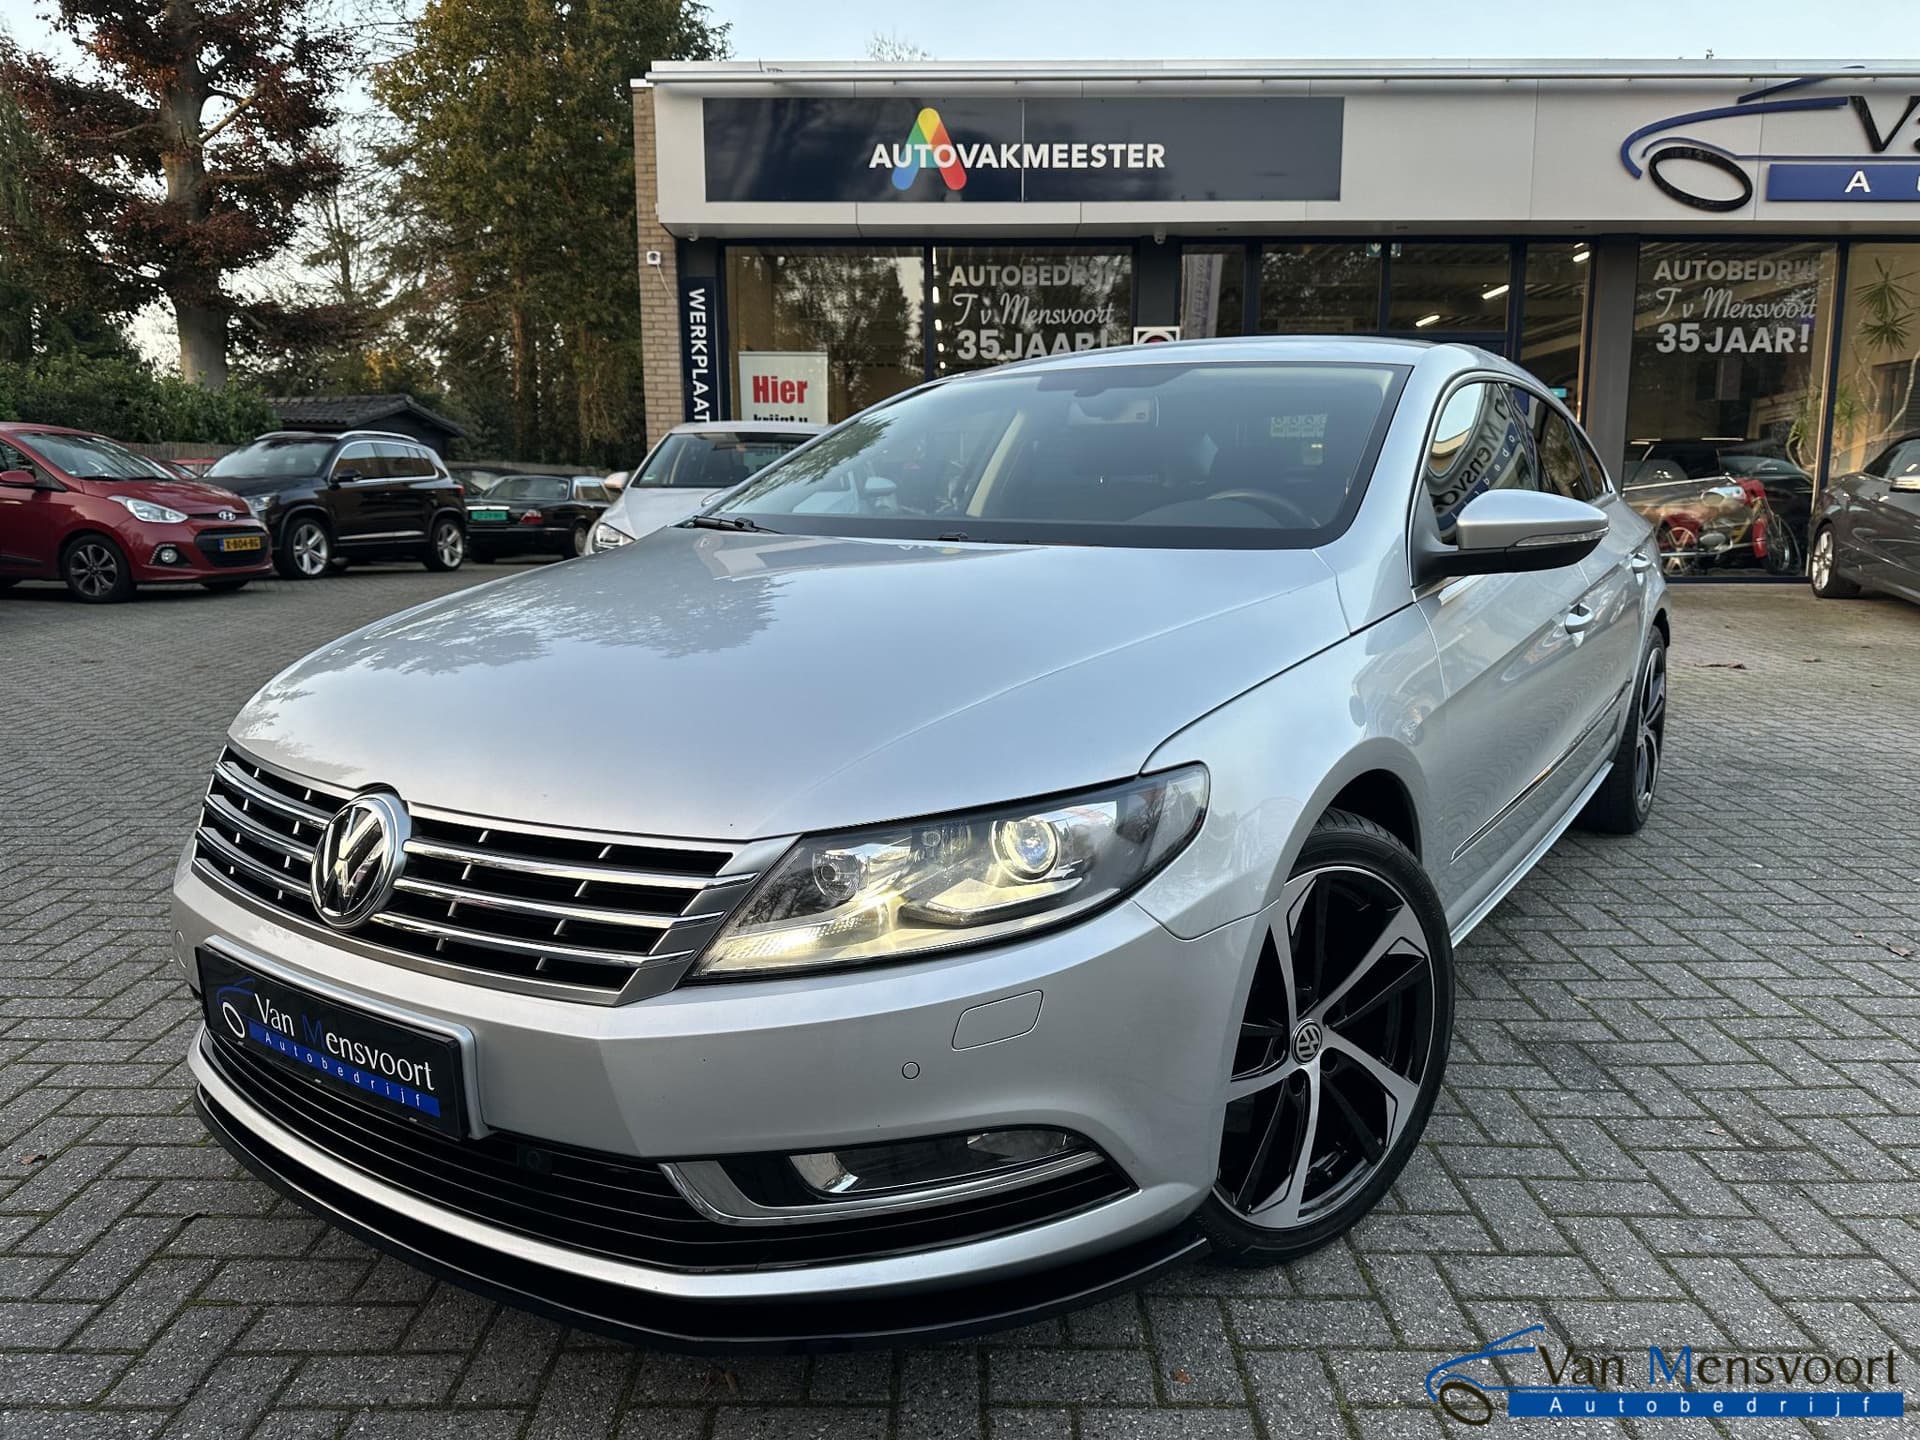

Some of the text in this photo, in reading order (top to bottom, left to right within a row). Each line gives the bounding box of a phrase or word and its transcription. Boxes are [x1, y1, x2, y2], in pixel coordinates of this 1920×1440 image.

[1849, 95, 1920, 153] V
[869, 143, 1165, 169] AUTOVAKMEESTER
[1000, 292, 1115, 325] Mensvoort
[1703, 286, 1818, 319] Mensvoort
[957, 329, 1001, 361] 35
[1656, 322, 1810, 353] 35 JAAR!
[752, 375, 808, 404] Hier
[254, 993, 435, 1092] Van Mensvoort
[264, 1032, 421, 1108] Autobedrijf
